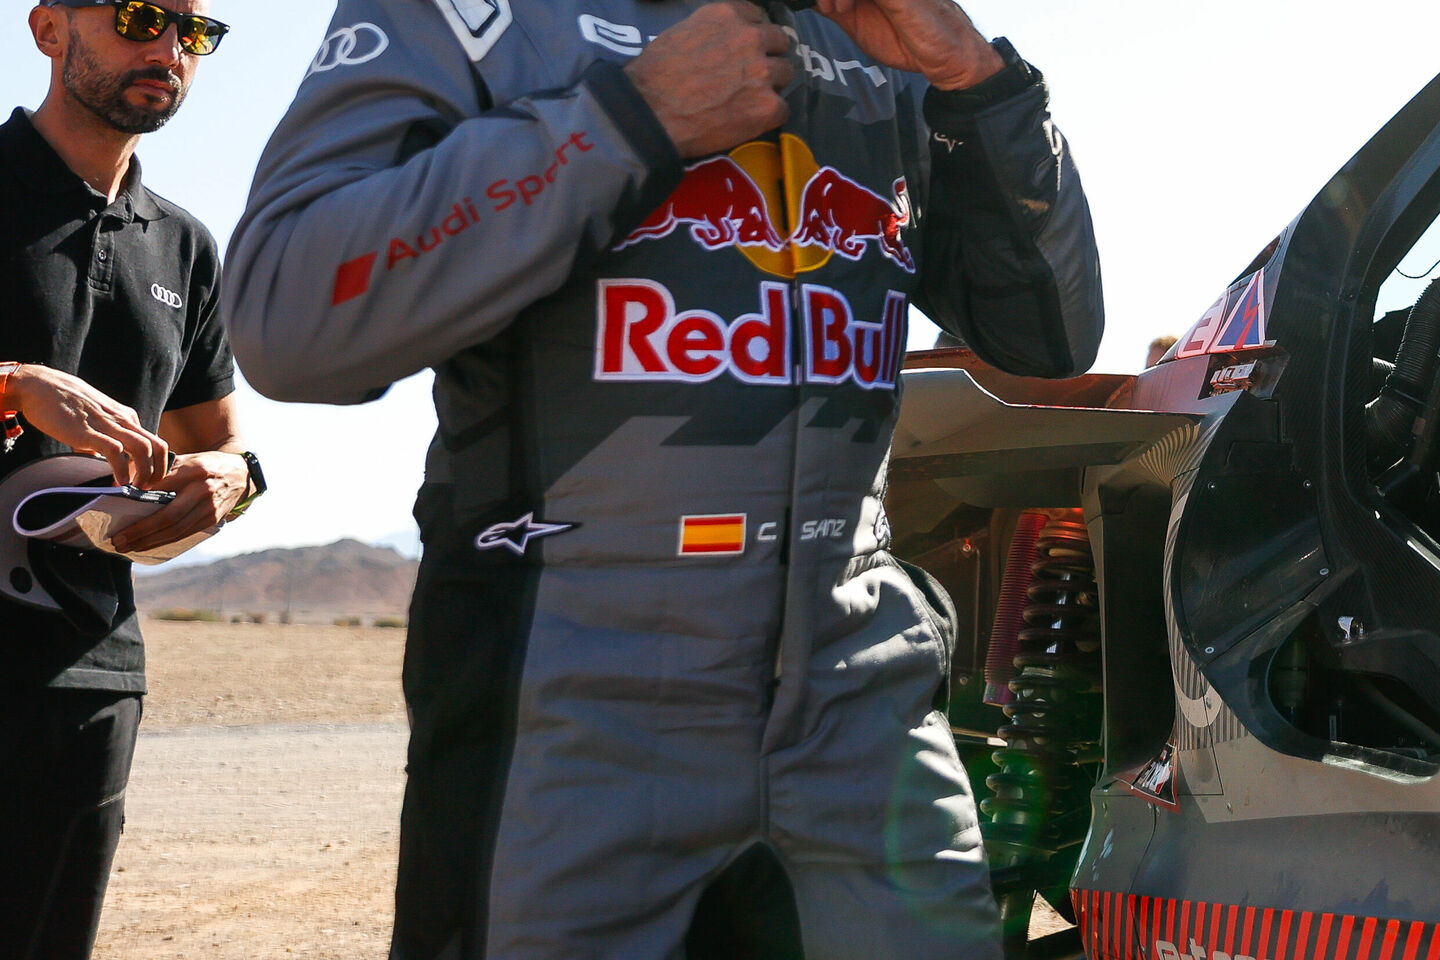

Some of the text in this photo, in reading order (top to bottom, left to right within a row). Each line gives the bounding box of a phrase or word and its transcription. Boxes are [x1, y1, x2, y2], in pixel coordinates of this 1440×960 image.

[386, 197, 481, 271] Audi
[594, 278, 907, 389] Red Bull
